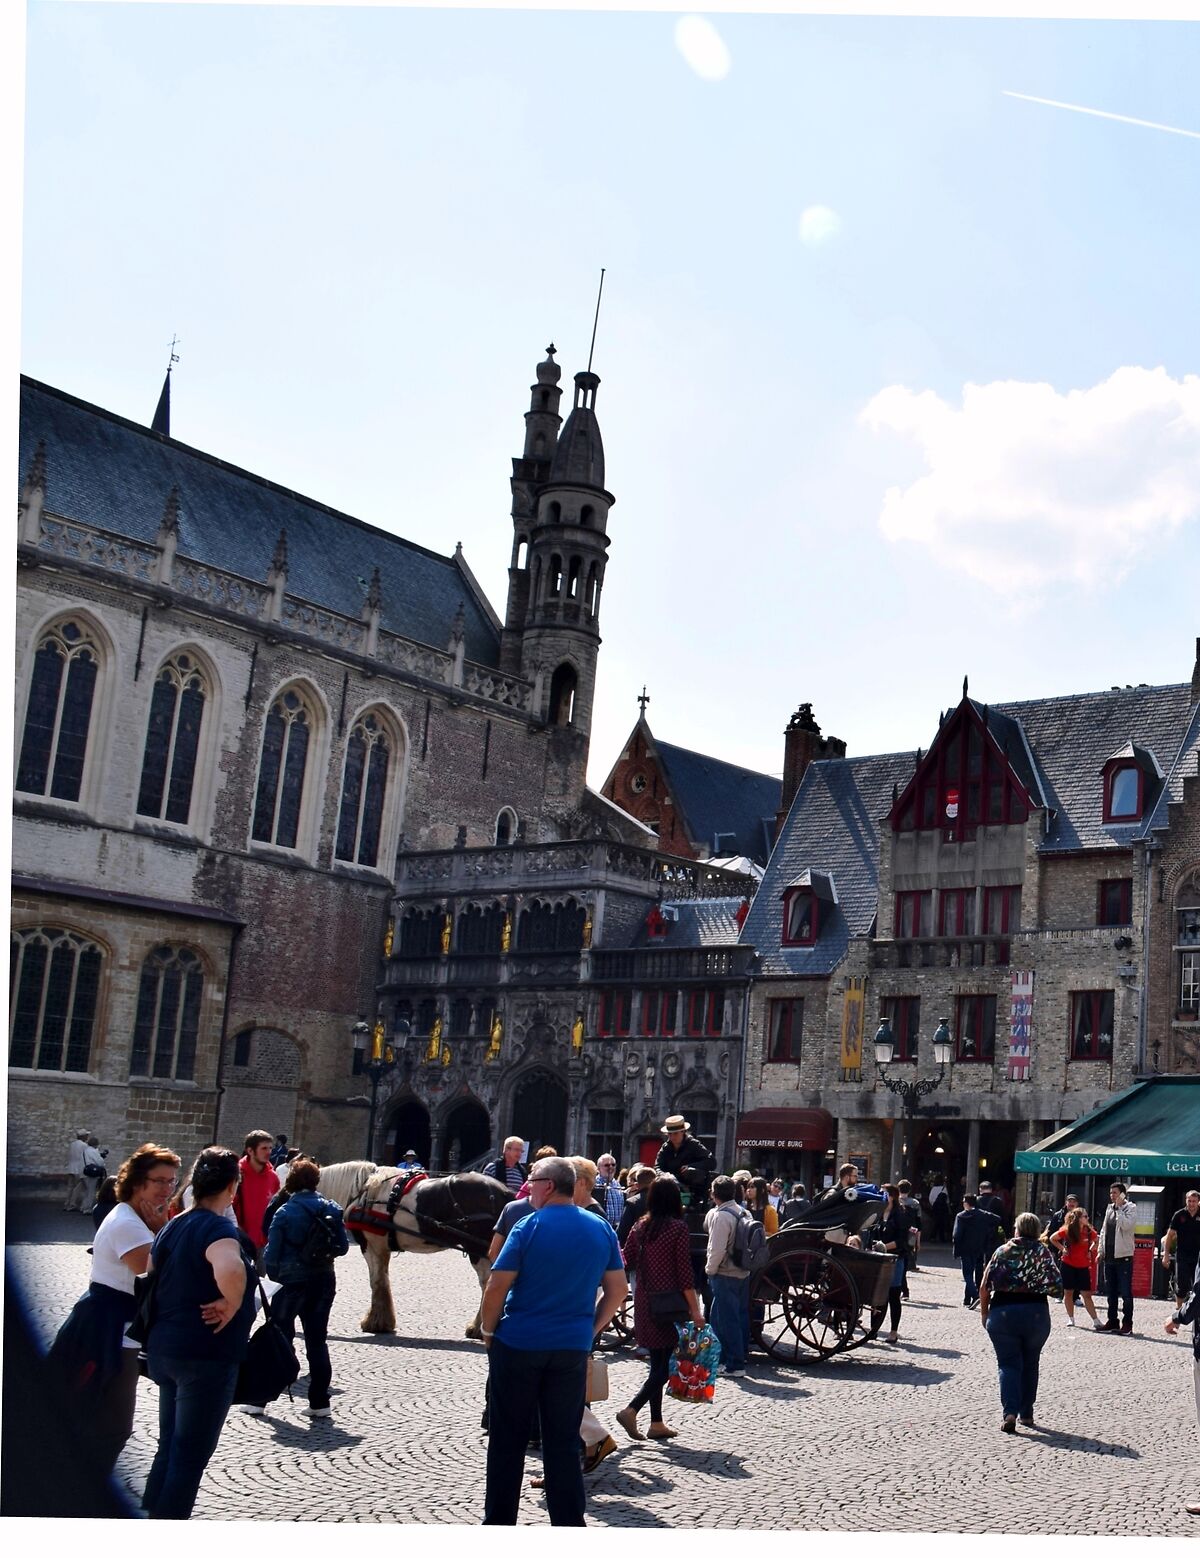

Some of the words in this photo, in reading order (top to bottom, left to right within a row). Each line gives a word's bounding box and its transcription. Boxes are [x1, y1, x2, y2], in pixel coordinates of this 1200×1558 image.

[737, 1139, 775, 1147] CHOCOLATERIE
[787, 1140, 803, 1148] BURG
[1040, 1156, 1072, 1169] TOM
[1080, 1157, 1129, 1171] POUCE
